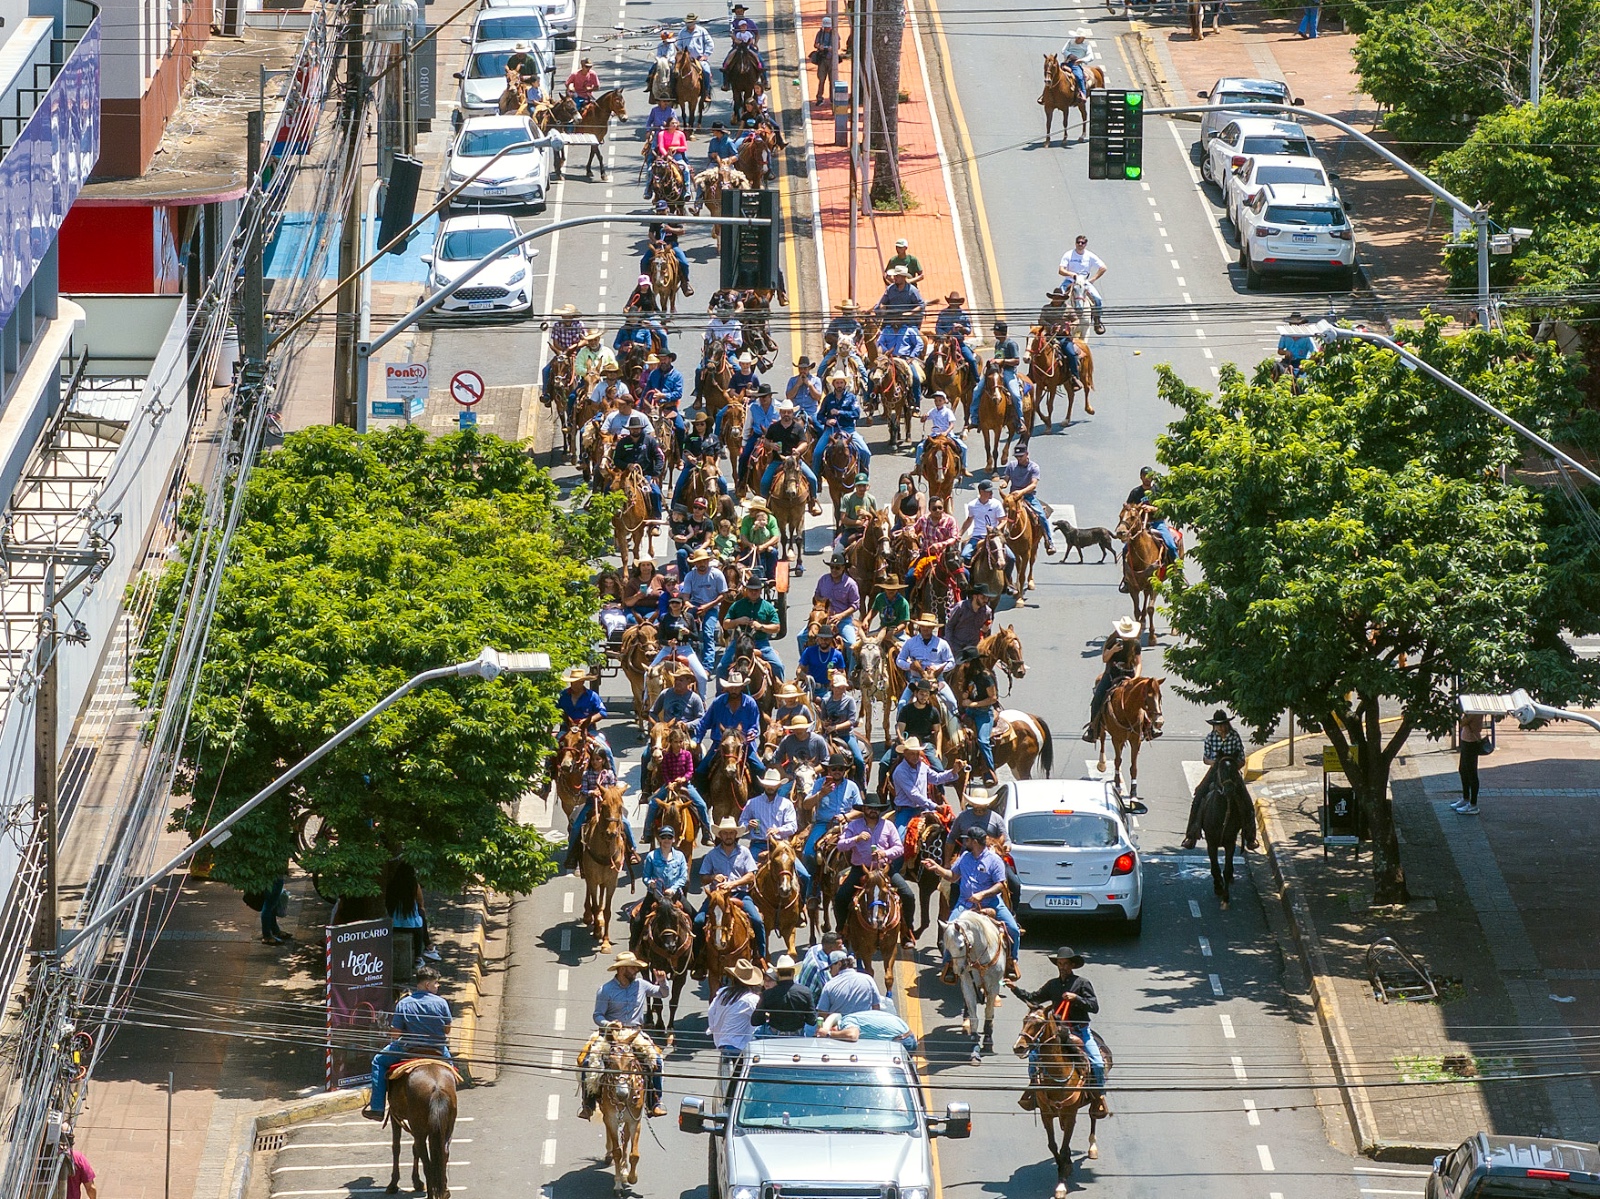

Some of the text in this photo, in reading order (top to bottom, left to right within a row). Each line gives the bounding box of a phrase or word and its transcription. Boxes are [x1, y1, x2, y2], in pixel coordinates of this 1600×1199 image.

[420, 66, 430, 107] JAMBO
[347, 950, 372, 968] her
[352, 956, 384, 977] code
